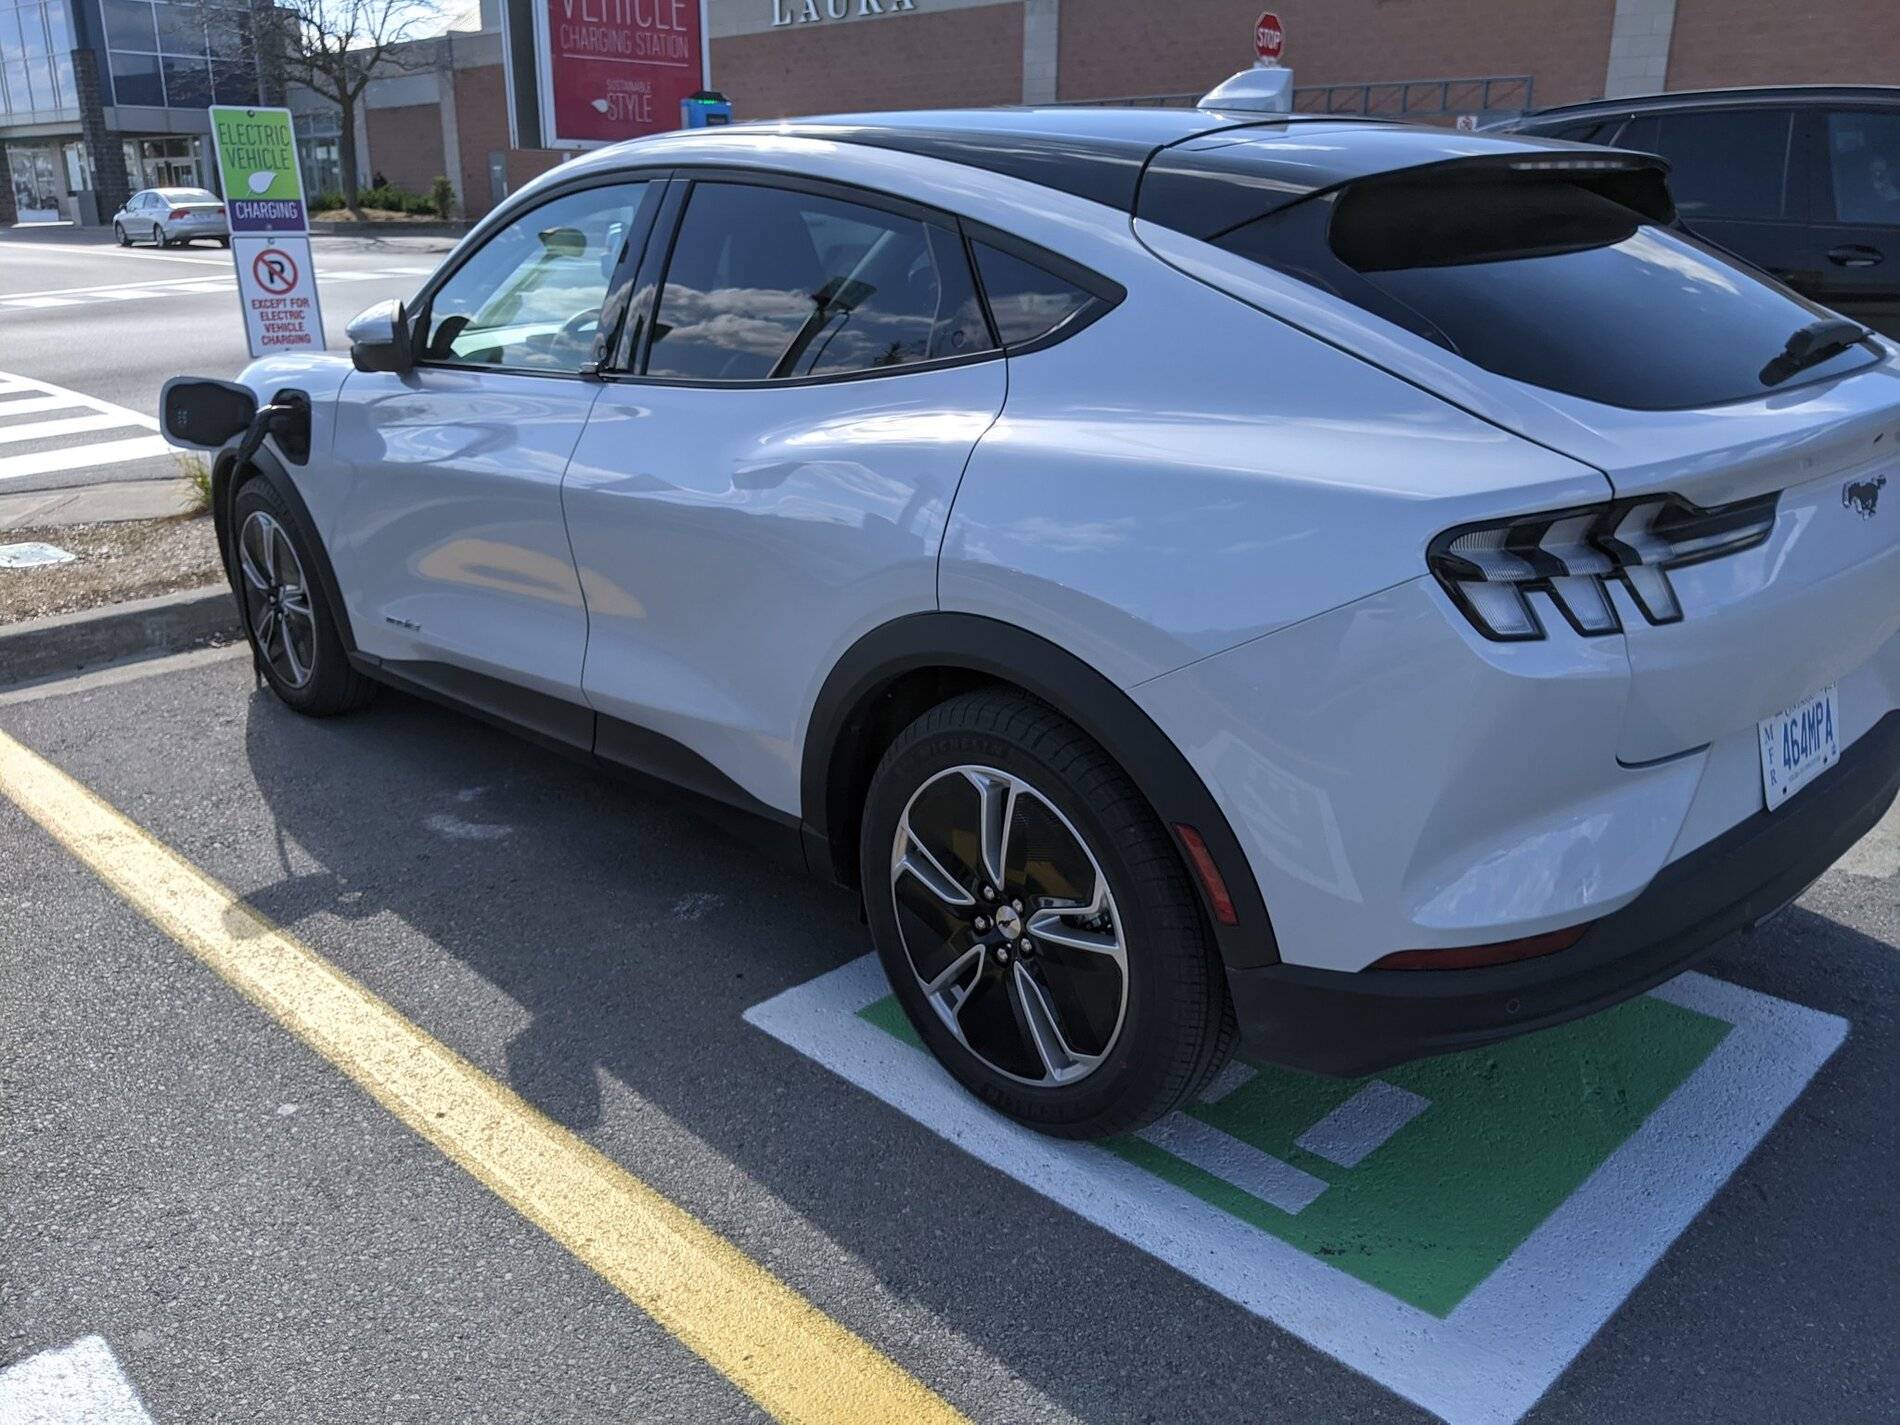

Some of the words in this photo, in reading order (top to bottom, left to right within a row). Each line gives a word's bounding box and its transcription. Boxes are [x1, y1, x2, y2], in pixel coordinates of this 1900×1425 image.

[560, 24, 632, 55] CHARGING
[636, 33, 689, 59] STATION
[1257, 28, 1281, 50] STOP
[607, 79, 652, 93] SUSTAINABLE
[608, 93, 653, 123] STYLE
[218, 123, 290, 146] ELECTRIC
[225, 147, 290, 170] VEHICLE
[235, 201, 298, 219] CHARGING
[252, 299, 288, 310] EXCEPT
[290, 298, 310, 309] FOR
[260, 310, 305, 321] ELECTRIC
[264, 322, 305, 333] VEHICLE
[261, 333, 312, 346] CHARGING
[1783, 696, 1834, 771] 464MPA
